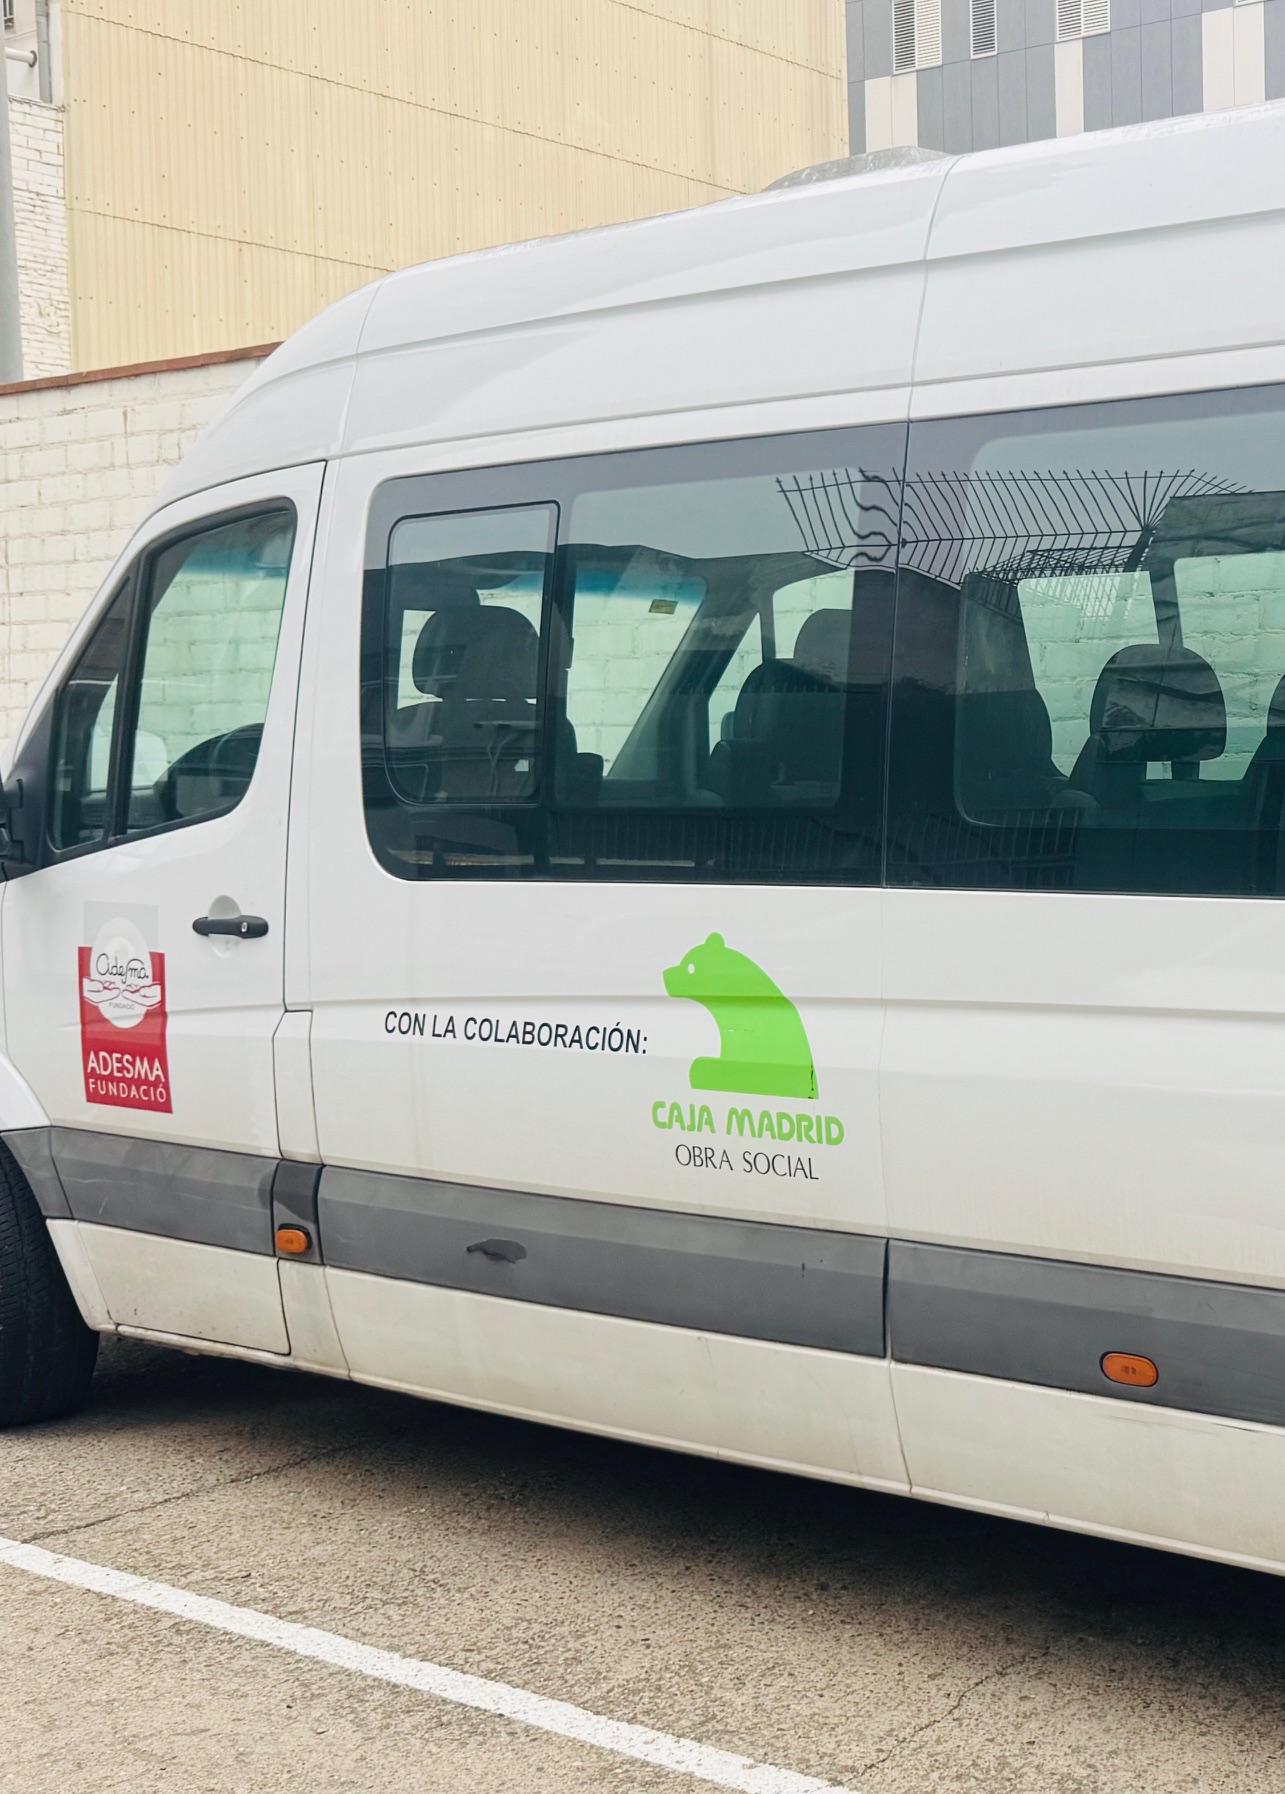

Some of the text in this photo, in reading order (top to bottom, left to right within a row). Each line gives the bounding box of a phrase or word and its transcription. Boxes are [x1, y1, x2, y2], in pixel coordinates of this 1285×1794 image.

[384, 1010, 648, 1055] CON LA COLABORACIÓN:
[87, 1050, 166, 1082] ADESMA
[88, 1078, 167, 1103] FUNDACIÓ
[651, 1100, 845, 1146] CAJA MADRID
[675, 1143, 820, 1180] OBRA SOCIAL
